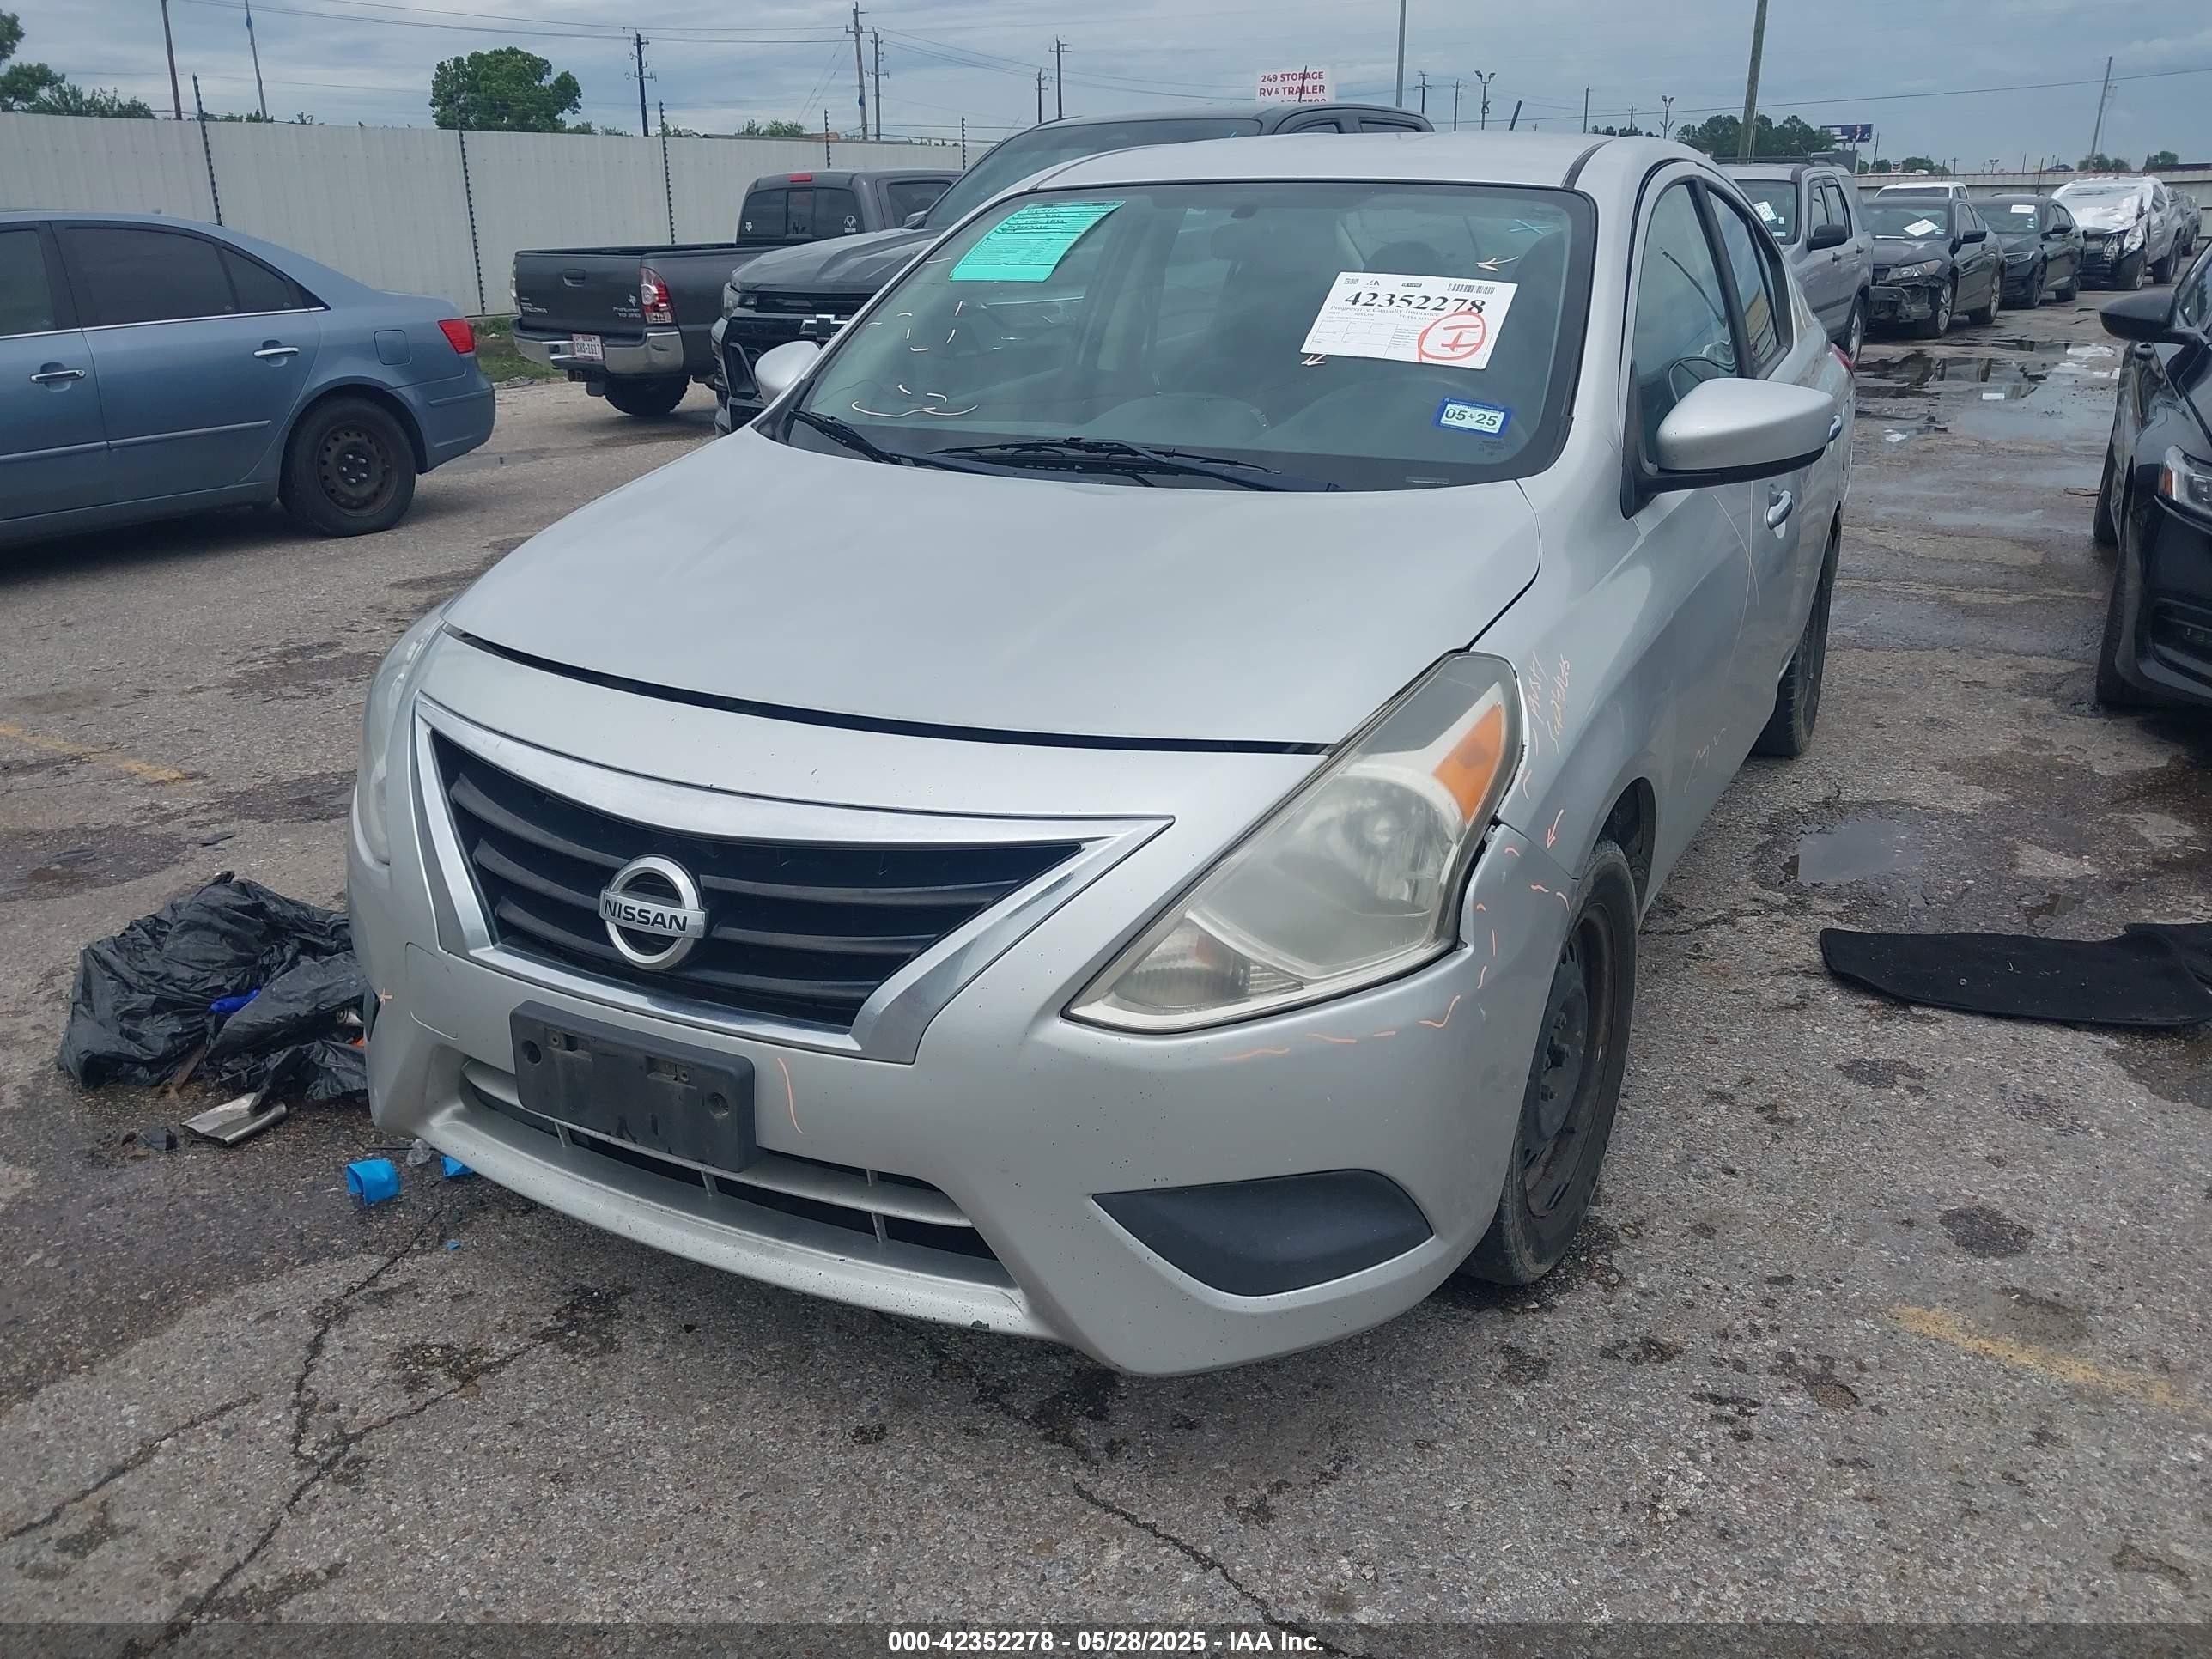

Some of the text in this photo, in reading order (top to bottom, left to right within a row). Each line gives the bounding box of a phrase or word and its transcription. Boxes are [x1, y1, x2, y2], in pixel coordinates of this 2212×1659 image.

[1261, 71, 1324, 83] 249 STORAGE
[1259, 88, 1274, 97] RV
[1282, 84, 1326, 96] TRAILER
[1344, 291, 1486, 314] 42352278
[604, 899, 688, 932] NISSAN
